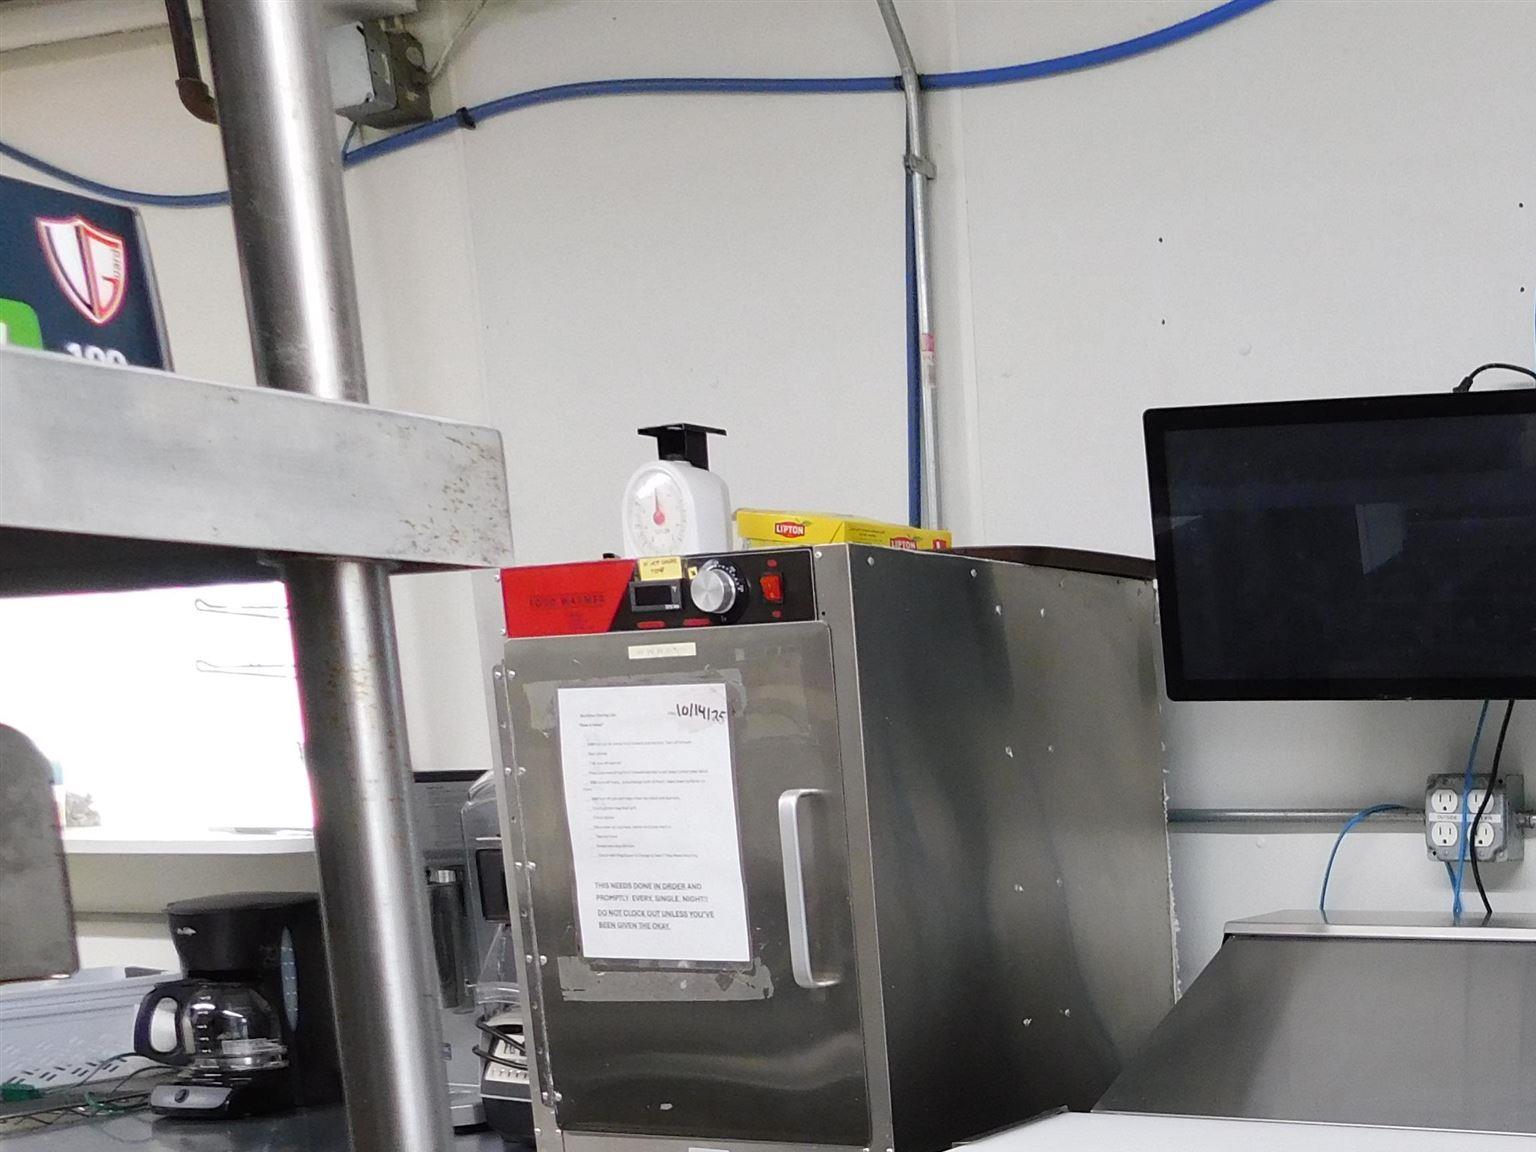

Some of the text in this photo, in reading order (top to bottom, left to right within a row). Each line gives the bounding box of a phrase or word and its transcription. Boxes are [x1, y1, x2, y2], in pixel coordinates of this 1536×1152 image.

[775, 524, 804, 535] LIPTON
[610, 882, 632, 890] NEEDS
[633, 882, 652, 890] DONE
[608, 909, 622, 917] NOT
[623, 909, 645, 917] CLOCK
[661, 910, 689, 918] UNLESS
[598, 921, 616, 929] BEEN
[616, 921, 638, 929] GIVEN
